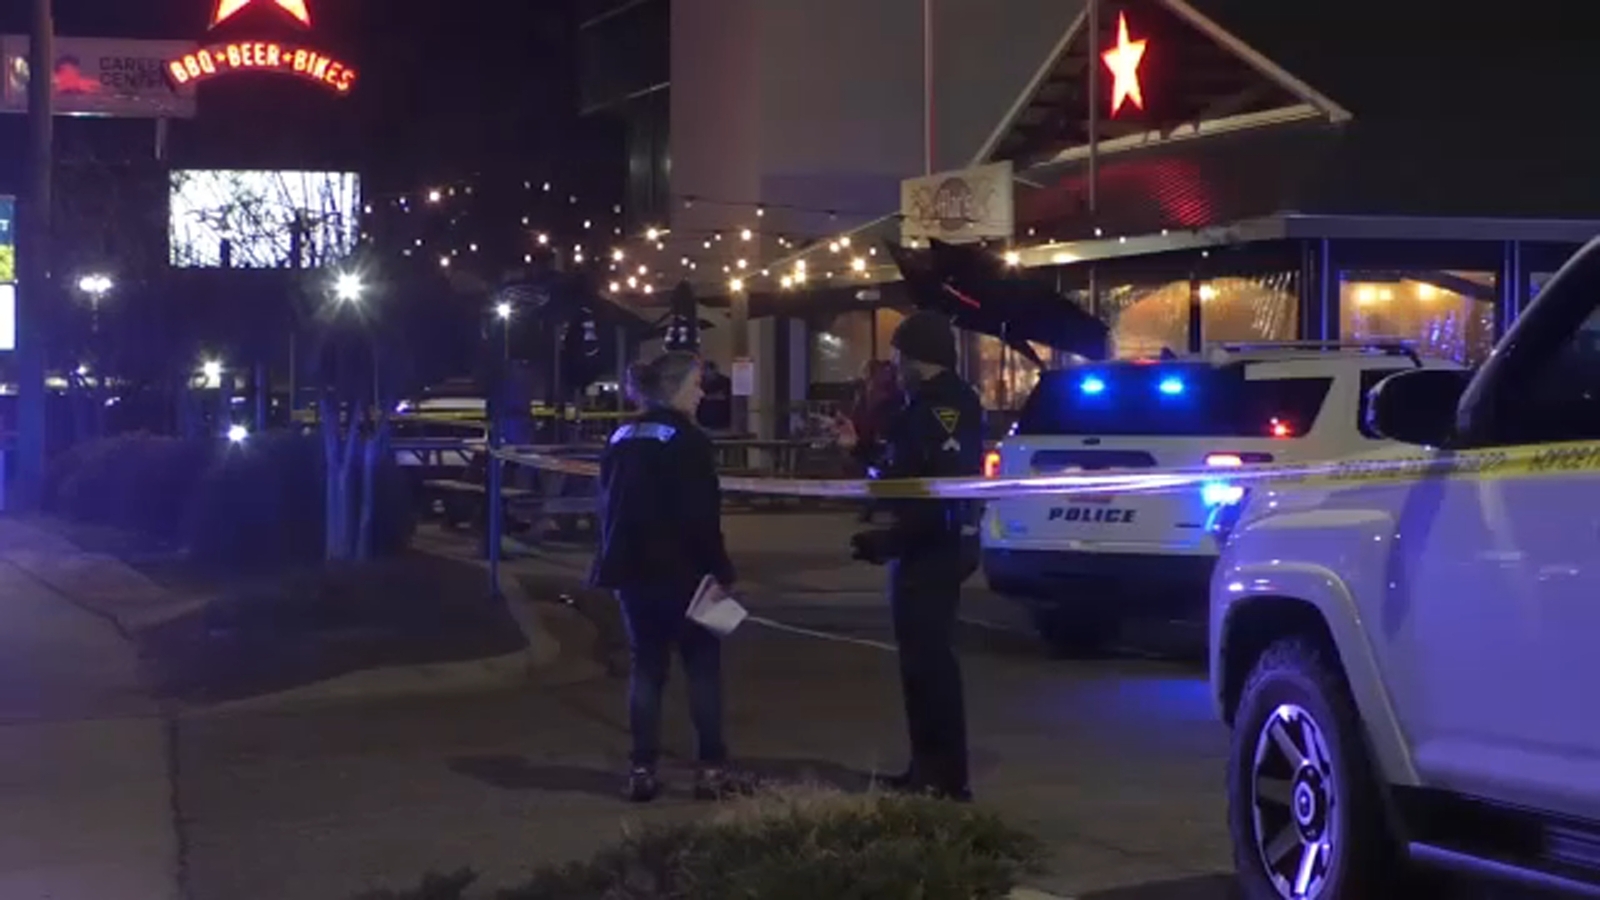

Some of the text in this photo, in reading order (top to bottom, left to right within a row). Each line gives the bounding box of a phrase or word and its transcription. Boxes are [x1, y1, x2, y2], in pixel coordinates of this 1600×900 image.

[169, 43, 355, 91] BBQ BEER BIKES
[1048, 507, 1137, 524] POLICE
